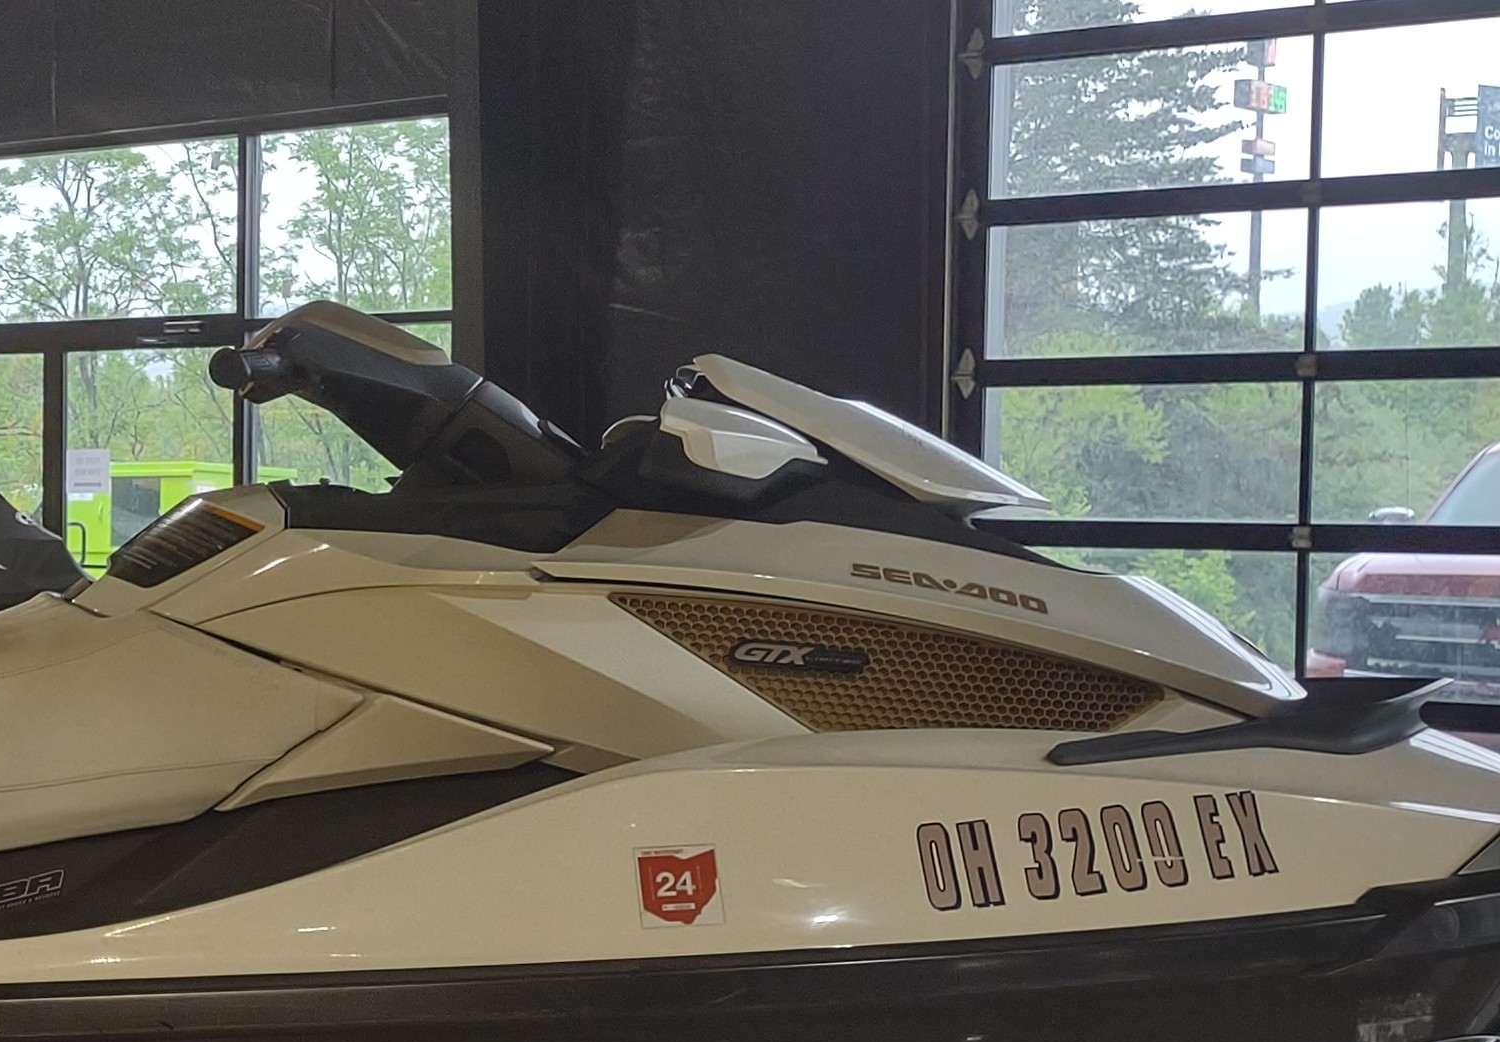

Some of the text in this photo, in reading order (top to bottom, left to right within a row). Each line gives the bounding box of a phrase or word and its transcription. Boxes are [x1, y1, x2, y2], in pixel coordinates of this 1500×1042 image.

[733, 642, 815, 666] GTX
[916, 790, 1280, 911] OH 3200 EX
[655, 870, 697, 898] 24
